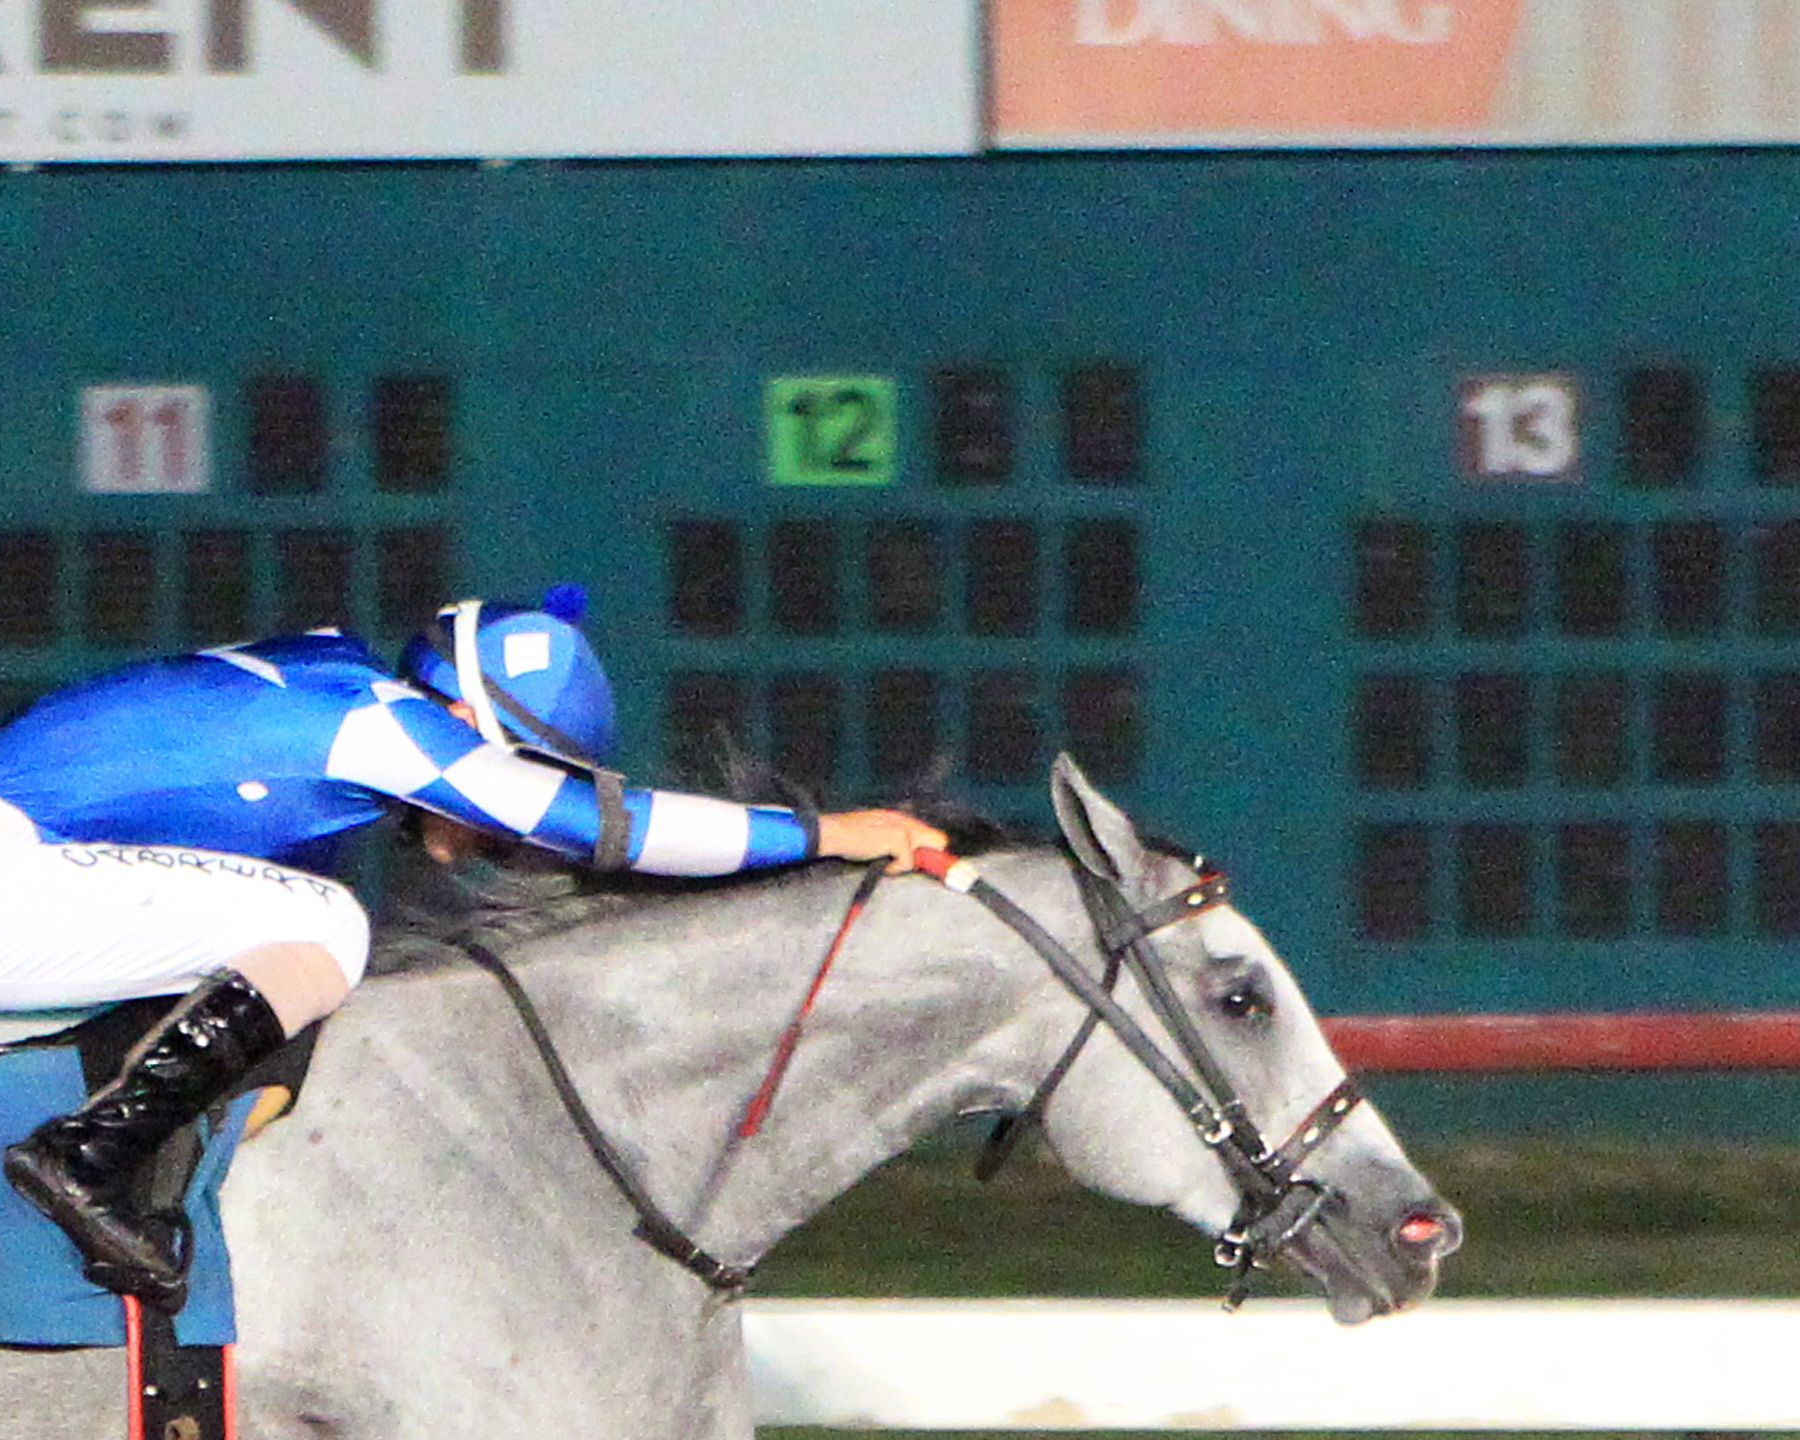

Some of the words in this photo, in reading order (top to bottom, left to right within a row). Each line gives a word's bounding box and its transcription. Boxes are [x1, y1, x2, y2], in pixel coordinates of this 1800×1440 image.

[102, 399, 190, 481] 11
[786, 388, 879, 472] 12
[1463, 386, 1573, 474] 13
[61, 847, 338, 905] CABRERA
